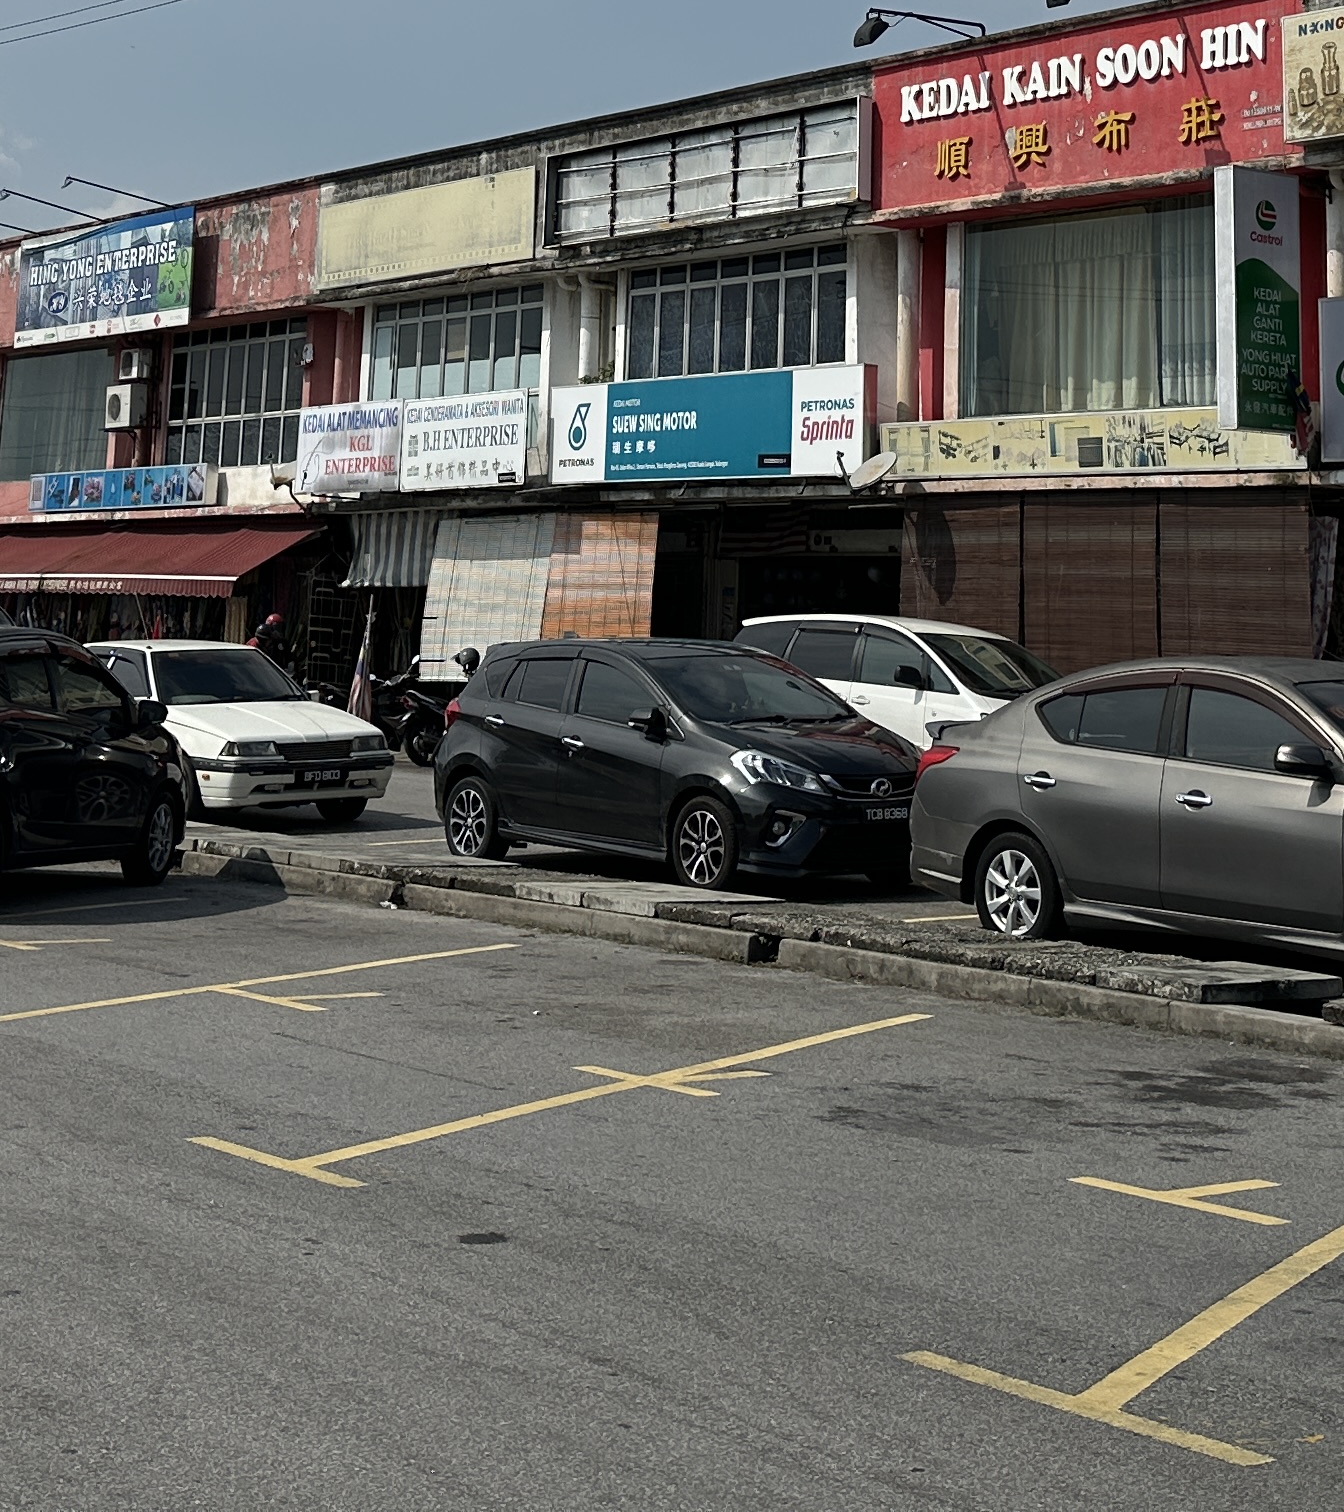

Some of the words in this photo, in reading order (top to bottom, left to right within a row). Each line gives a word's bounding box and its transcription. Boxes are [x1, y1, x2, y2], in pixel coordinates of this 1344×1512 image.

[900, 70, 992, 124] KEDAI
[1002, 53, 1084, 106] KAIN
[1096, 34, 1185, 87] SOON
[1200, 19, 1266, 69] HIN
[934, 97, 1224, 178] 順興布莊
[1250, 231, 1283, 246] Castrol
[29, 262, 58, 287] HING
[62, 255, 93, 281] YONG
[95, 239, 177, 275] ENTERPRISE
[1253, 286, 1282, 302] KEDAI
[1256, 301, 1280, 316] ALAT
[1253, 316, 1283, 332] GANTI
[1250, 330, 1287, 347] KERETA
[1242, 348, 1269, 363] YONG
[1271, 351, 1296, 366] HUAT
[1241, 363, 1267, 377] AUTO
[1252, 378, 1287, 394] SUPPLY
[501, 398, 524, 416] WANITA
[800, 397, 855, 412] PETRONAS
[302, 415, 325, 434] KEDAI
[325, 411, 347, 432] ALAT
[347, 407, 398, 431] MEMANCING
[612, 415, 637, 434] SUEW
[639, 413, 661, 432] SING
[663, 411, 697, 431] MOTOR
[443, 424, 519, 451] ENTERPRISE
[801, 415, 854, 445] Sprinta
[349, 435, 373, 453] KGL
[324, 454, 396, 476] ENTERPRISE
[558, 458, 595, 468] PETRONAS
[866, 809, 883, 820] TCB
